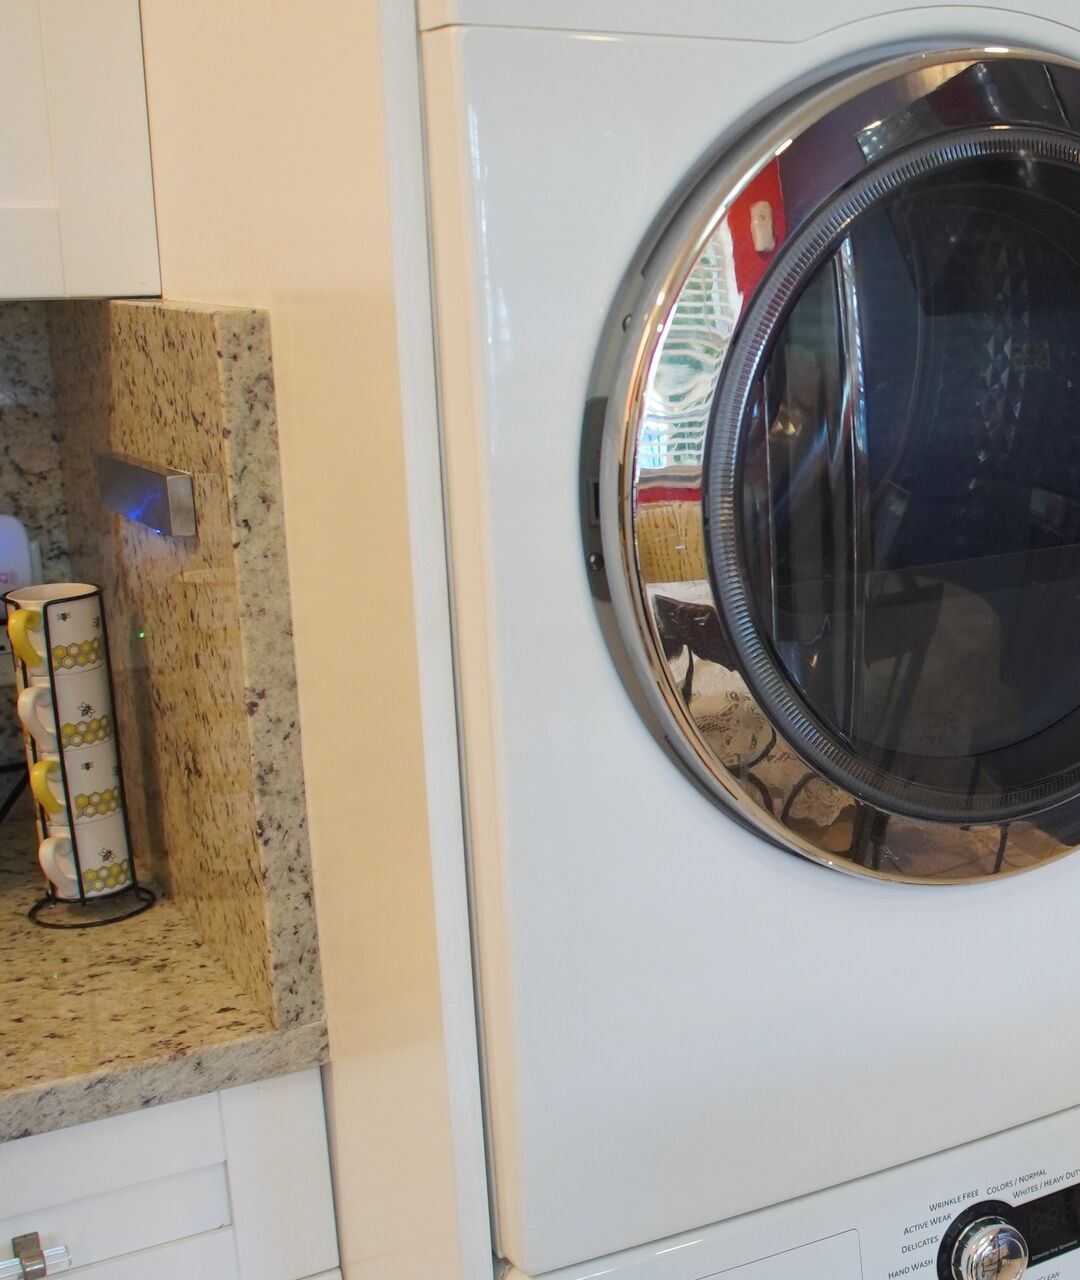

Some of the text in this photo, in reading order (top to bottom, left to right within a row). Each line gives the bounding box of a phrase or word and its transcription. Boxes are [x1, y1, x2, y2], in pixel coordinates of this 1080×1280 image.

[986, 1180, 1013, 1195] COLORS
[1018, 1169, 1047, 1184] NORMAL
[1013, 1184, 1038, 1199] WHITES
[1043, 1175, 1065, 1188] HEAVY
[929, 1189, 979, 1212] WRINKLE FREE
[903, 1213, 952, 1236] ACTIVE WEAR
[901, 1235, 939, 1254] DELICATES
[888, 1258, 933, 1280] HAND WASH
